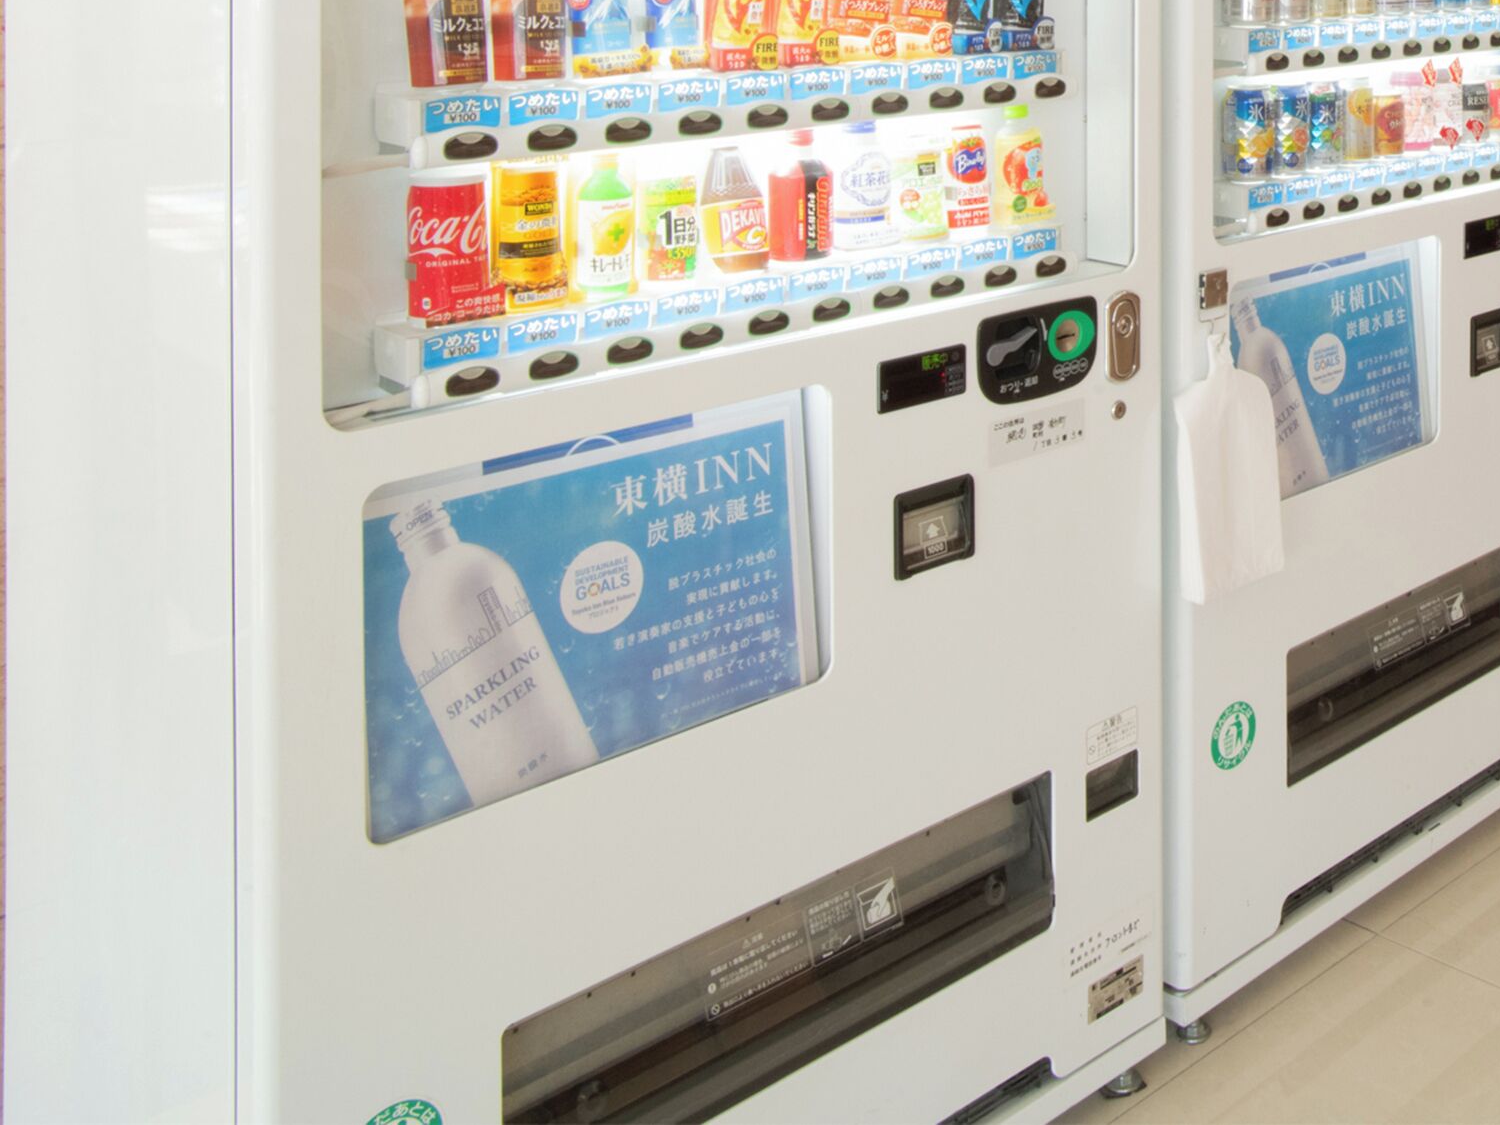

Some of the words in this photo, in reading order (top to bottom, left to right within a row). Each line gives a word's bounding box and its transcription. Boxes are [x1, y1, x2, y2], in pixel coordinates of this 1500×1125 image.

[852, 64, 902, 79] つめたい
[908, 59, 957, 74] つめたい
[962, 56, 1008, 71] つめたい
[728, 73, 784, 88] つめたい
[791, 68, 845, 83] つめたい
[588, 84, 650, 101] つめたい
[660, 79, 719, 95] つめたい
[430, 98, 500, 115] つめたい
[511, 90, 577, 108] つめたい
[963, 237, 1007, 254] つめたい
[425, 258, 472, 268] ORIGINAL
[909, 247, 956, 265] つめたい
[791, 267, 844, 287] つめたい
[852, 258, 901, 276] つめたい
[727, 277, 786, 298] つめたい
[1328, 273, 1407, 318] 東横INN
[659, 289, 717, 310] つめたい
[587, 301, 649, 322] つめたい
[510, 313, 576, 335] つめたい
[1346, 306, 1408, 341] 炭酸水誕生
[427, 329, 498, 350] つめたい
[1275, 399, 1301, 430] KLING
[1277, 419, 1301, 447] ATER
[611, 442, 774, 519] 東横INN
[646, 490, 775, 548] 炭酸水誕生
[576, 572, 631, 601] GOALS
[445, 645, 541, 721] SPARKLING
[469, 676, 537, 732] WATER
